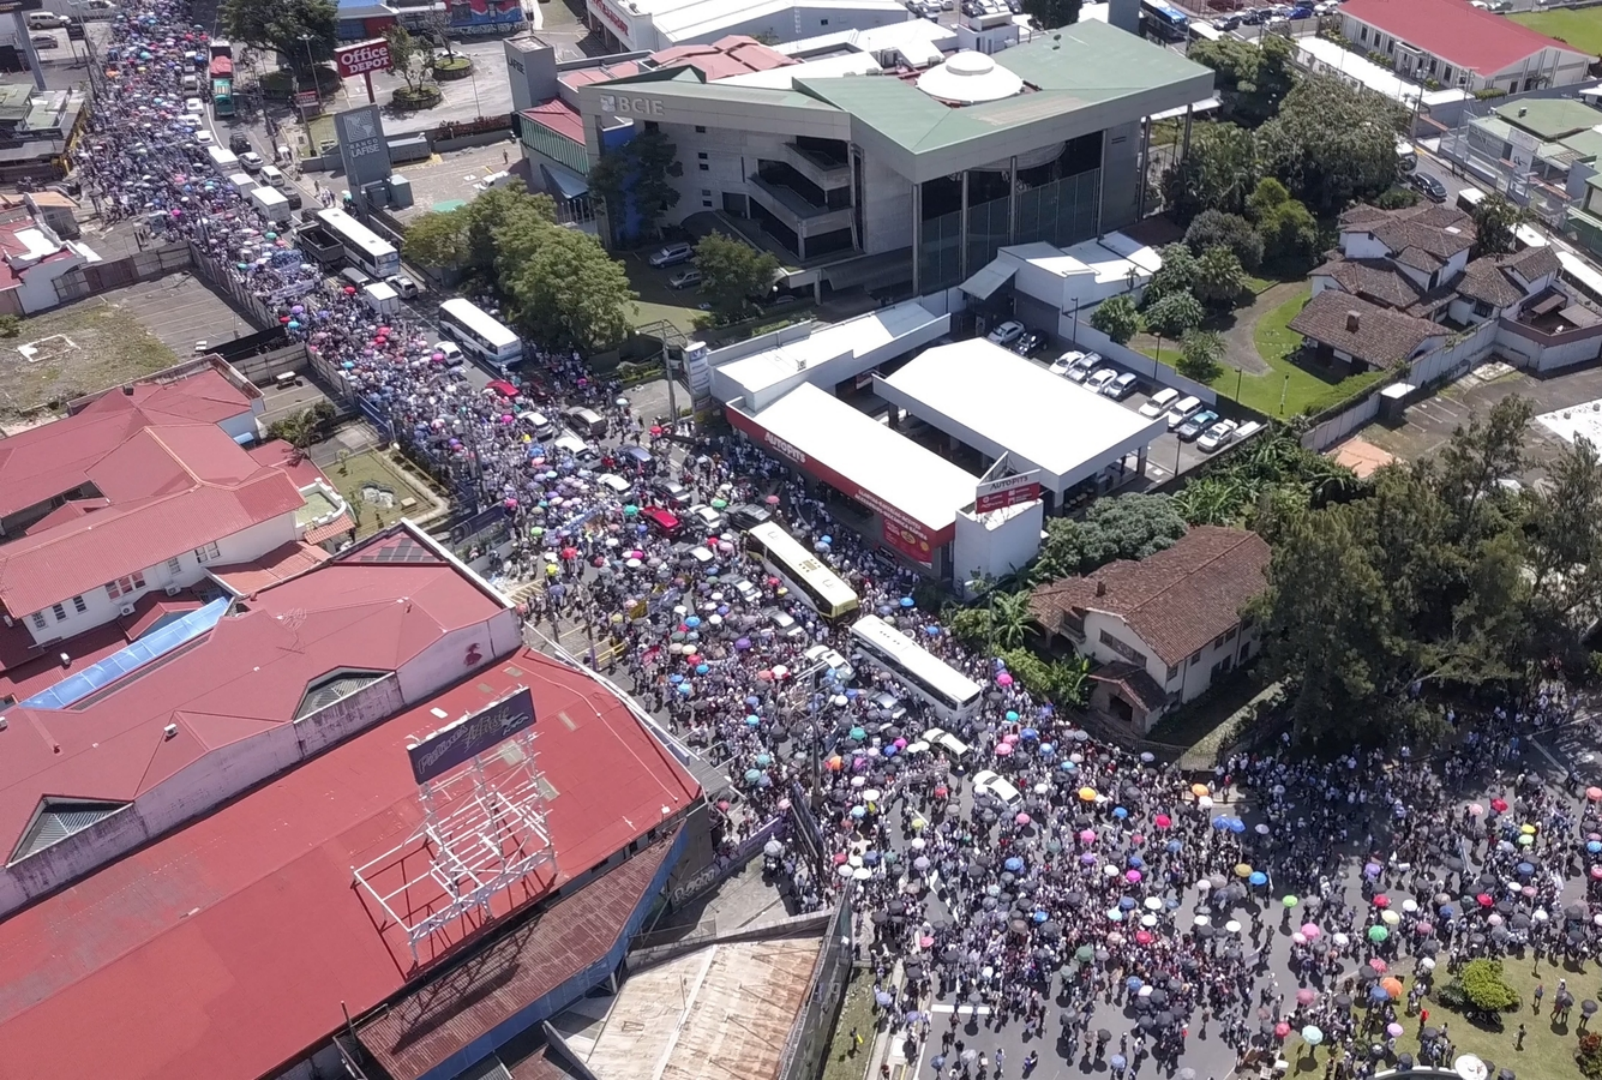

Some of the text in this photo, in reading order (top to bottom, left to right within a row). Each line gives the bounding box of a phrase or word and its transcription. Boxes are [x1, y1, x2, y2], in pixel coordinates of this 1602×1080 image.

[341, 47, 388, 66] Office
[349, 56, 389, 74] DEPOT
[619, 96, 666, 116] BCIE
[350, 138, 378, 150] BANCO
[351, 143, 380, 158] LAFISE
